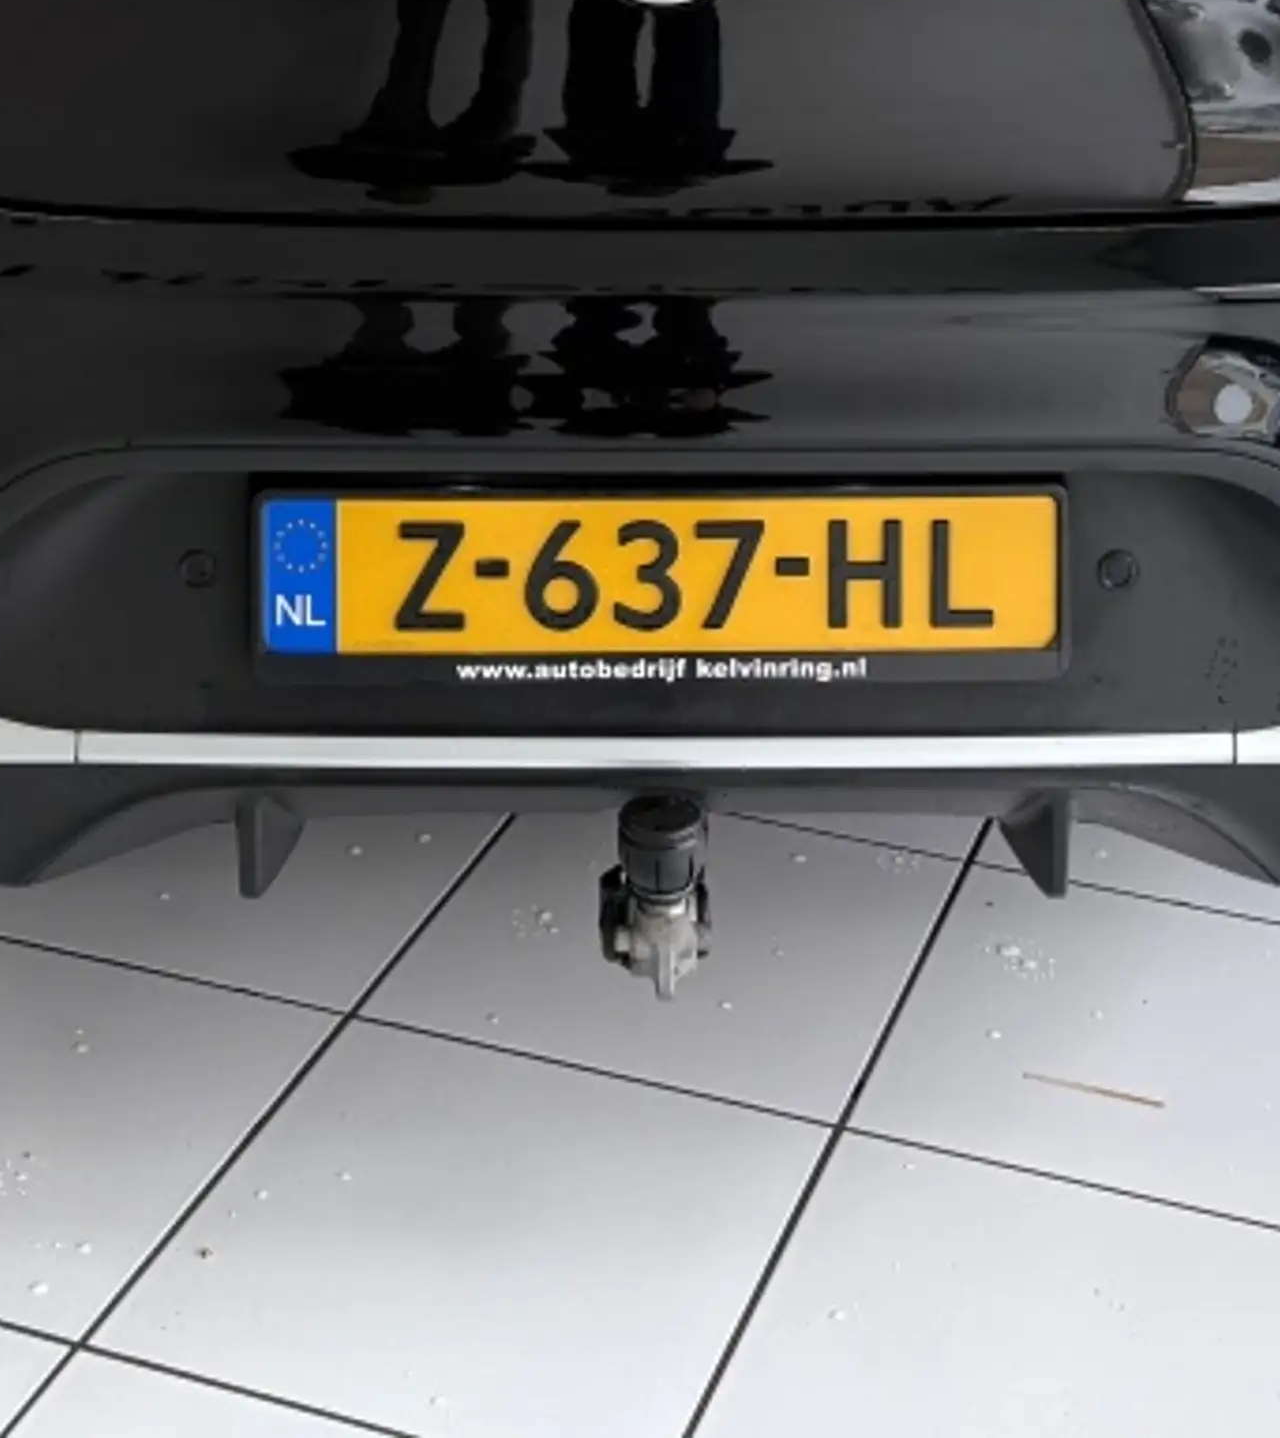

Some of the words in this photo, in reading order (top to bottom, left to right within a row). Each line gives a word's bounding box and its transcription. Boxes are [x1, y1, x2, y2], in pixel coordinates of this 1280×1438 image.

[393, 518, 995, 633] Z-637-HL
[274, 593, 327, 628] NL
[455, 657, 688, 684] www.autobedrijf
[695, 656, 868, 683] kelvinring.nl
